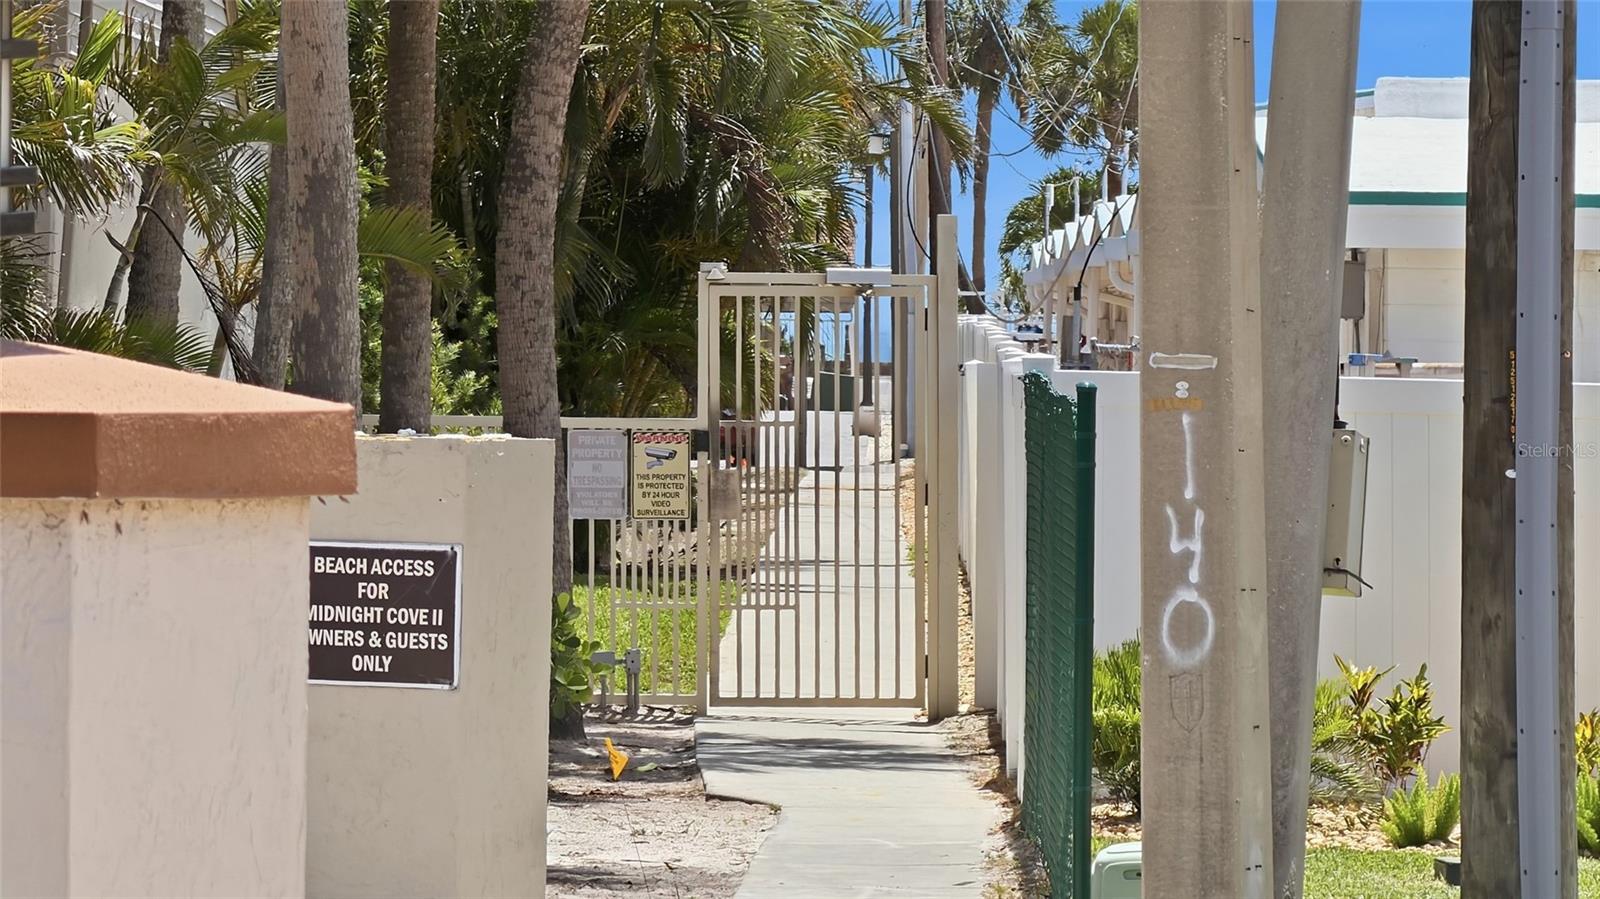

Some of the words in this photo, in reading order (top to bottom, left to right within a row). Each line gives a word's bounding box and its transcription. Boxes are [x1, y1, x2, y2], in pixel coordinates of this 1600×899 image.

[578, 435, 616, 446] PRIVATE
[571, 448, 623, 458] PROPERTY
[636, 473, 651, 481] THIS
[652, 473, 686, 481] PROPERTY
[646, 482, 685, 490] PROTECTED
[651, 500, 671, 508] VIDEO
[637, 509, 685, 517] SURVEILLANCE
[314, 556, 367, 574] BEACH
[370, 559, 435, 577] ACCESS
[358, 582, 389, 600] FOR
[386, 607, 429, 625] COVE
[432, 608, 443, 626] II
[309, 628, 364, 647] WNERS
[368, 631, 382, 648] &
[385, 632, 448, 650] GUESTS
[351, 654, 393, 672] ONLY
